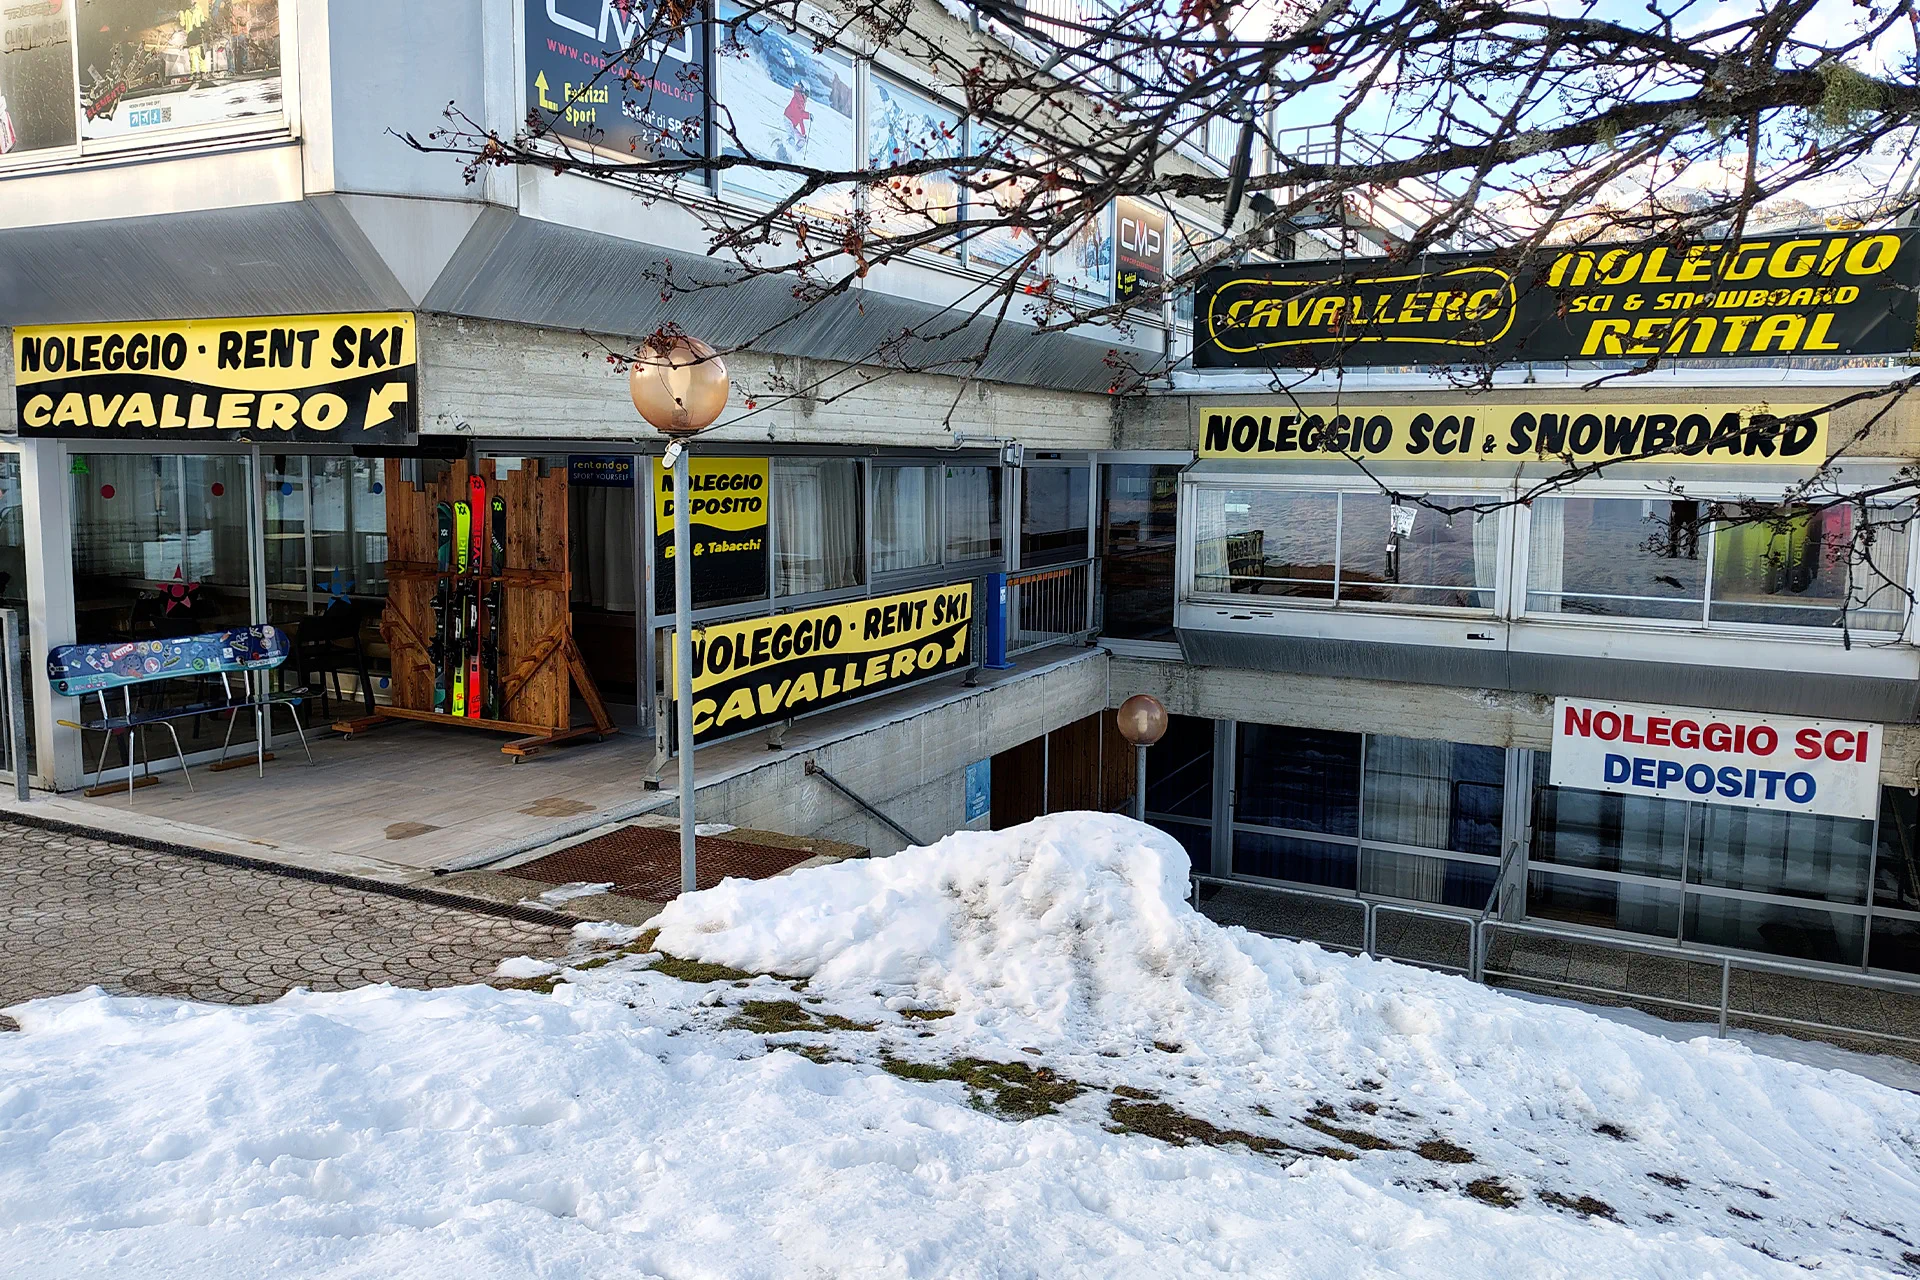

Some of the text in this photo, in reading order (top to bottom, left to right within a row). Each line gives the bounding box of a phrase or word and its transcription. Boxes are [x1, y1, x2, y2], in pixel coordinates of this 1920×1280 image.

[86, 81, 126, 118] ELEMENTS
[565, 106, 596, 127] Sport
[657, 114, 666, 128] di
[1121, 217, 1160, 257] CMP
[1547, 235, 1901, 287] NOLEGGIO
[1227, 289, 1504, 328] CAVALLERO
[1569, 285, 1860, 313] SCI & SNOWBOARD
[21, 332, 188, 372] NOLEGGIO
[217, 328, 320, 370] RENT
[331, 325, 404, 369] SKI
[1580, 312, 1841, 356] RENTAL
[23, 391, 348, 431] CAVALLERO
[1204, 412, 1818, 457] NOLEGGIO SCI & SNOWBOARD
[595, 473, 629, 481] YOURSELF
[663, 496, 762, 517] DPOSITO
[693, 543, 704, 556] &
[708, 538, 762, 554] Tabacchi
[111, 643, 134, 660] NITRO
[691, 614, 842, 679] NOLEGGIO
[863, 599, 928, 641] RENT
[932, 592, 968, 626] SKI
[692, 642, 943, 735] CAVALLERO
[1564, 706, 1869, 763] NOLEGGIO SCI
[1603, 753, 1817, 804] DEPOSITO
